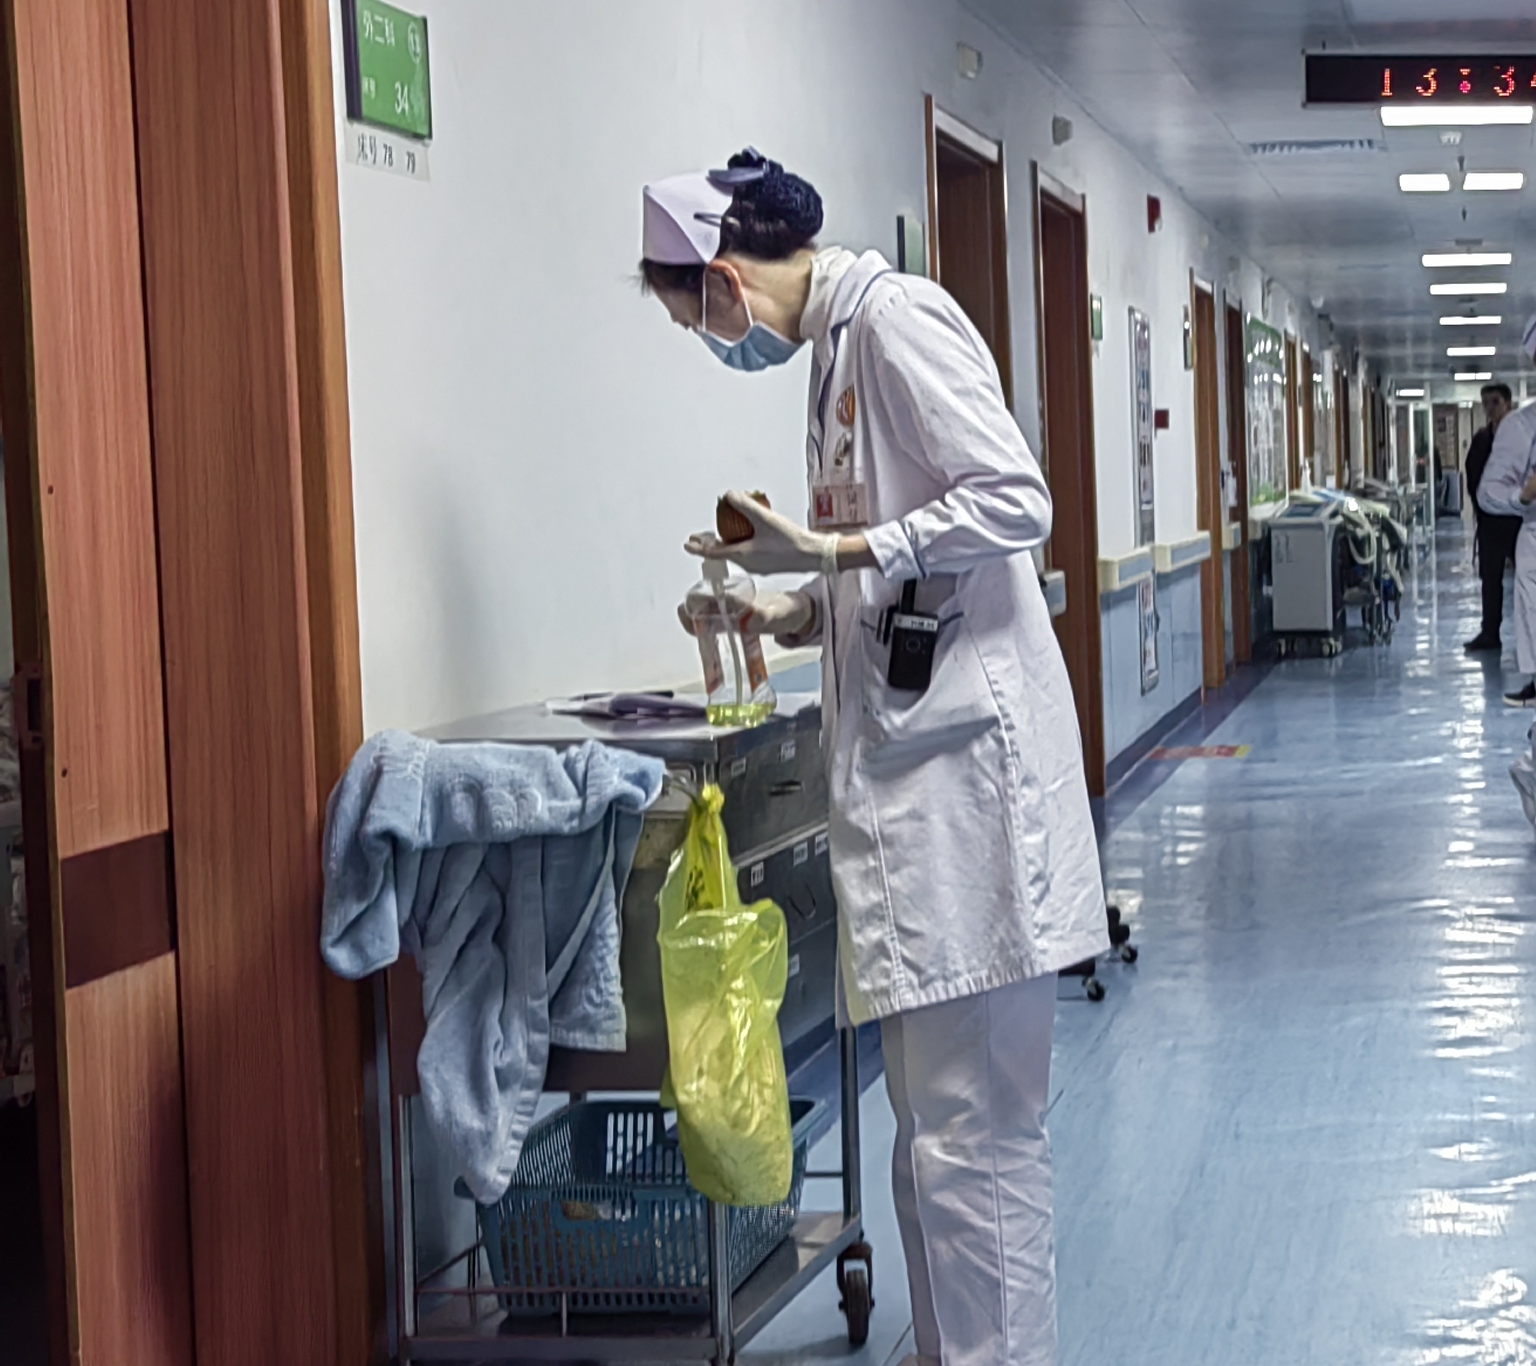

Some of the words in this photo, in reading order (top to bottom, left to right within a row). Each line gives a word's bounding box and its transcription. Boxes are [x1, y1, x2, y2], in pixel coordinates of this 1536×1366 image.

[363, 10, 395, 47] 外二科
[394, 81, 410, 116] 34
[383, 143, 393, 167] 78
